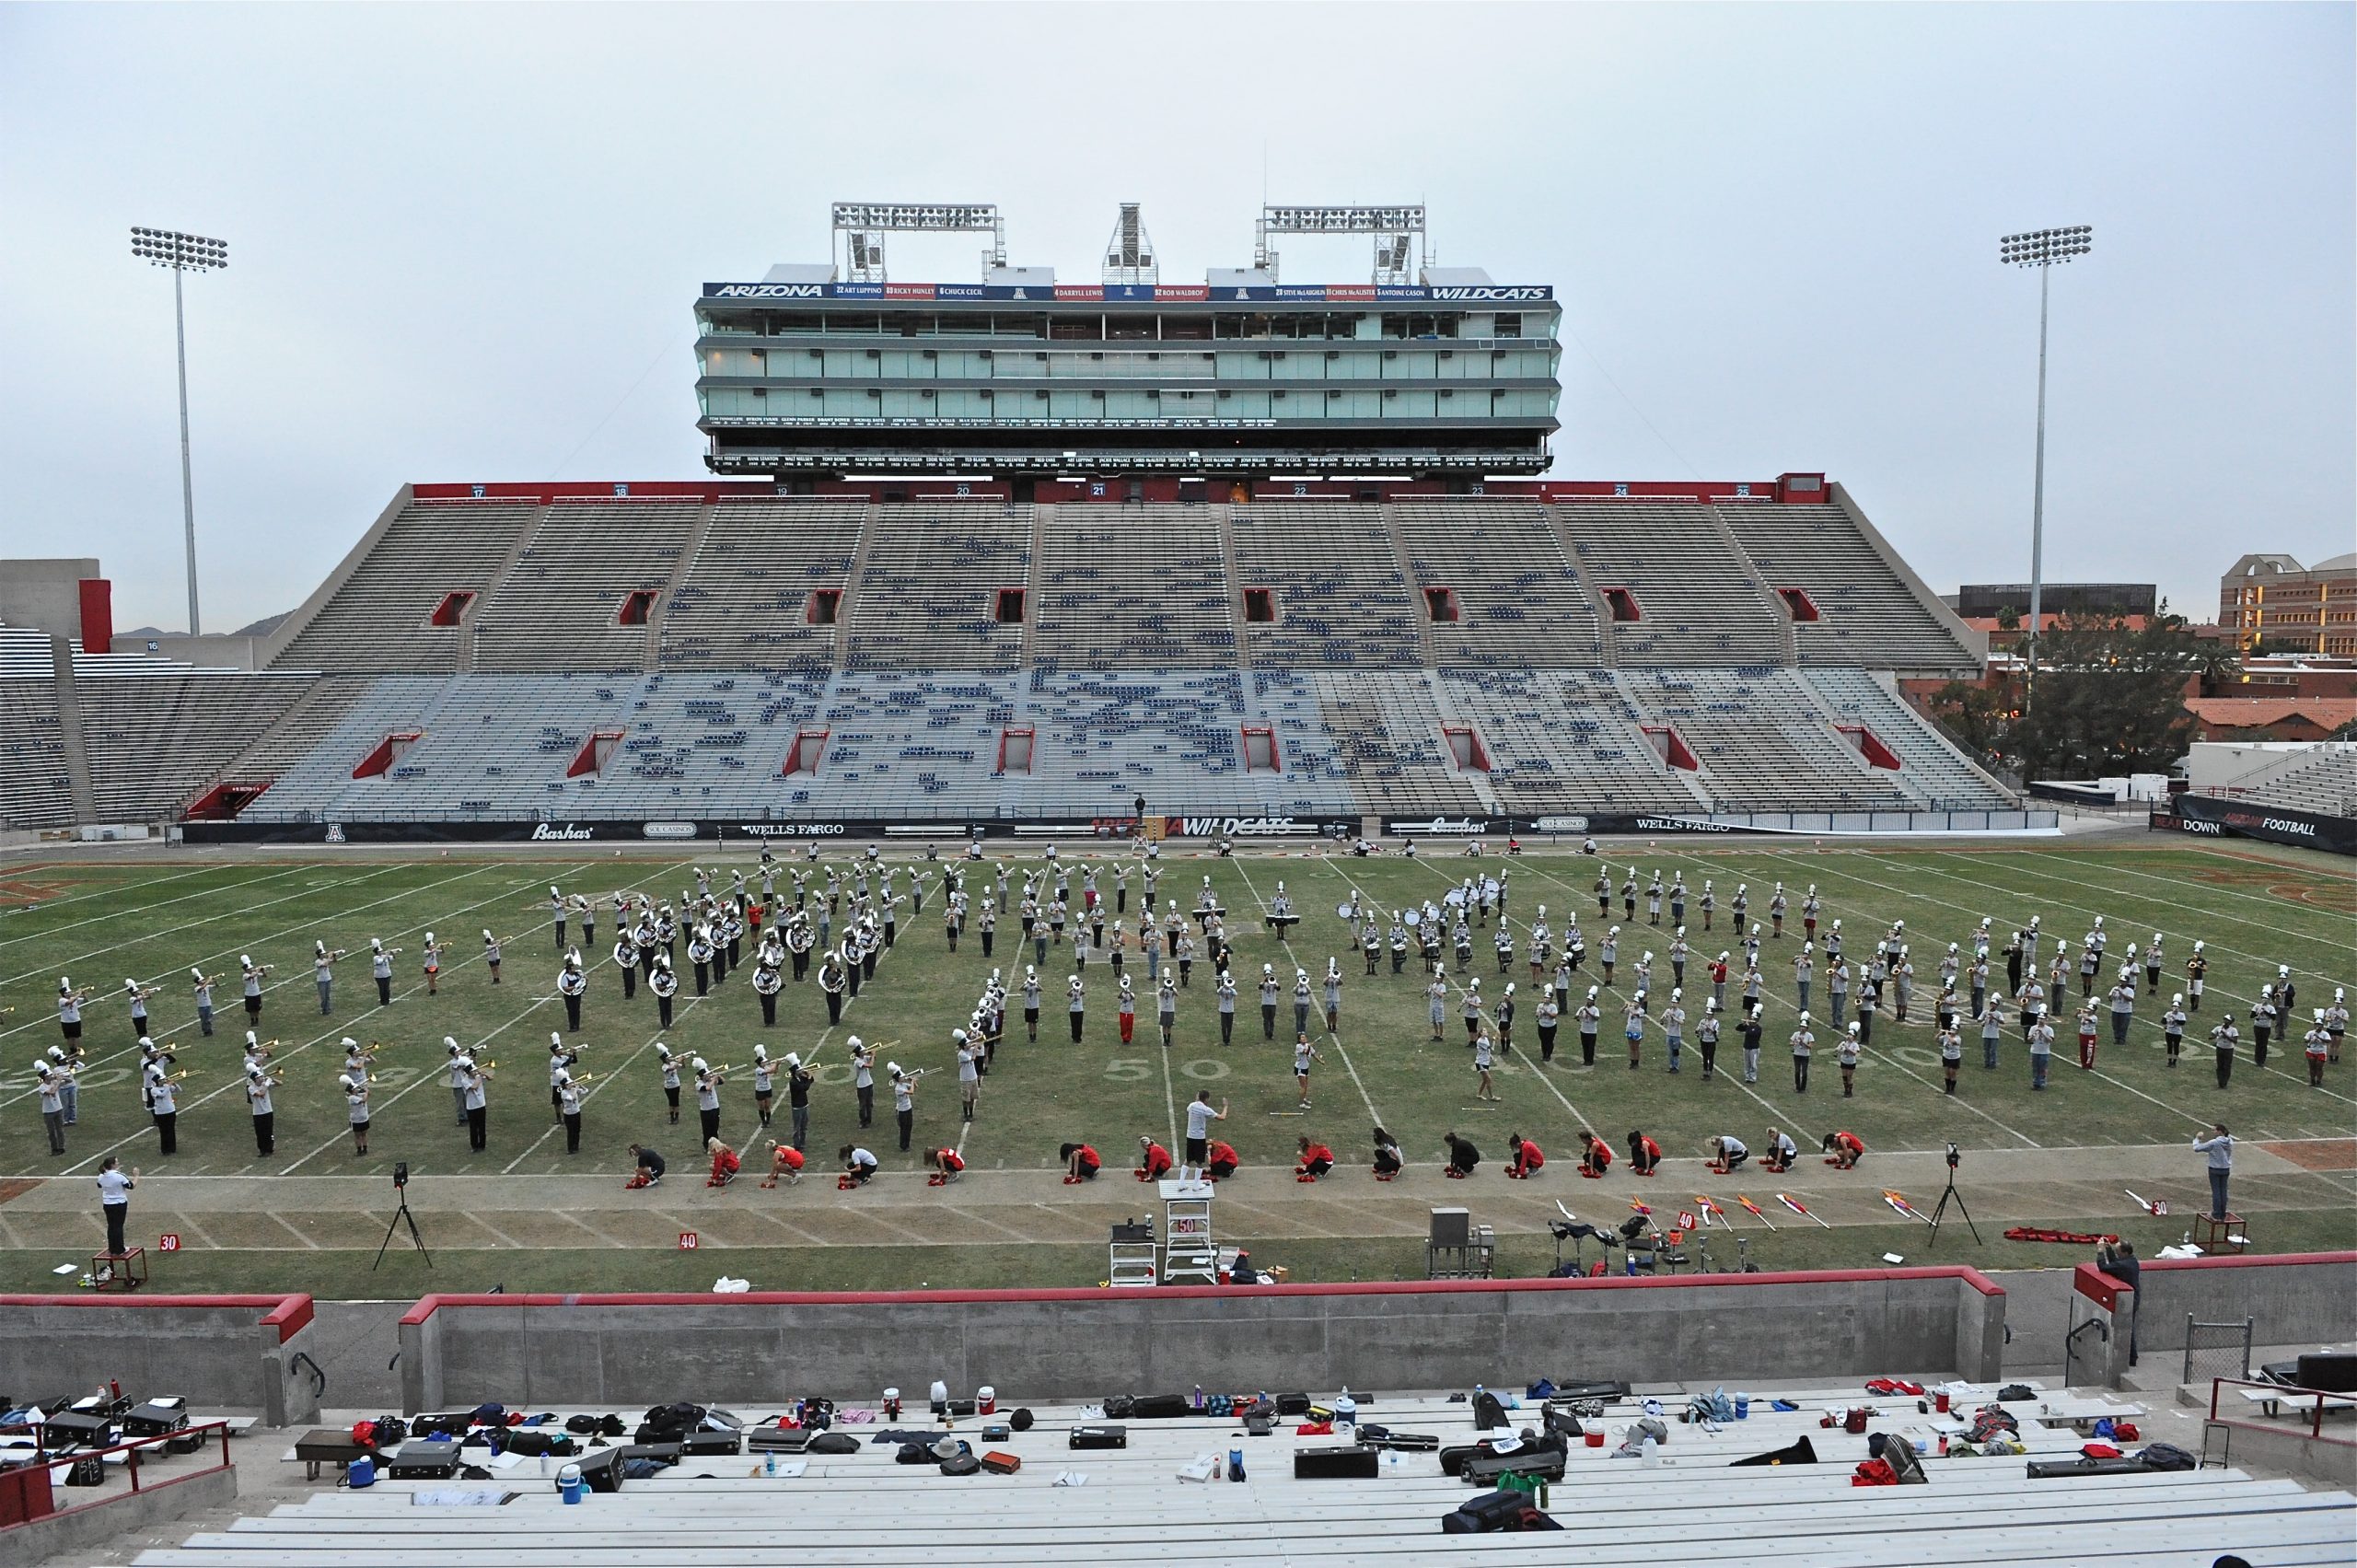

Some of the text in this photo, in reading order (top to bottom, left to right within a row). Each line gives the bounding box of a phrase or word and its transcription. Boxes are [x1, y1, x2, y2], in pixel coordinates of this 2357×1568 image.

[714, 285, 822, 296] ARIZONA
[1433, 288, 1546, 299] WILDCATS
[615, 488, 626, 496] 18
[958, 487, 970, 495] 20
[1093, 486, 1104, 494] 21
[1295, 487, 1306, 495] 22
[1472, 487, 1483, 495] 23
[148, 642, 157, 650] 16
[748, 825, 844, 835] WELLS FARGO
[1637, 819, 1683, 830] WELLS
[2183, 819, 2220, 834] DOWN
[2262, 818, 2315, 836] FOOTBALL
[531, 823, 593, 840] Bashas'
[1105, 1059, 1232, 1081] 50
[2154, 1201, 2167, 1215] 30
[1179, 1219, 1195, 1232] 50
[1678, 1213, 1692, 1228] 40
[160, 1234, 179, 1250] 30
[679, 1234, 697, 1249] 40
